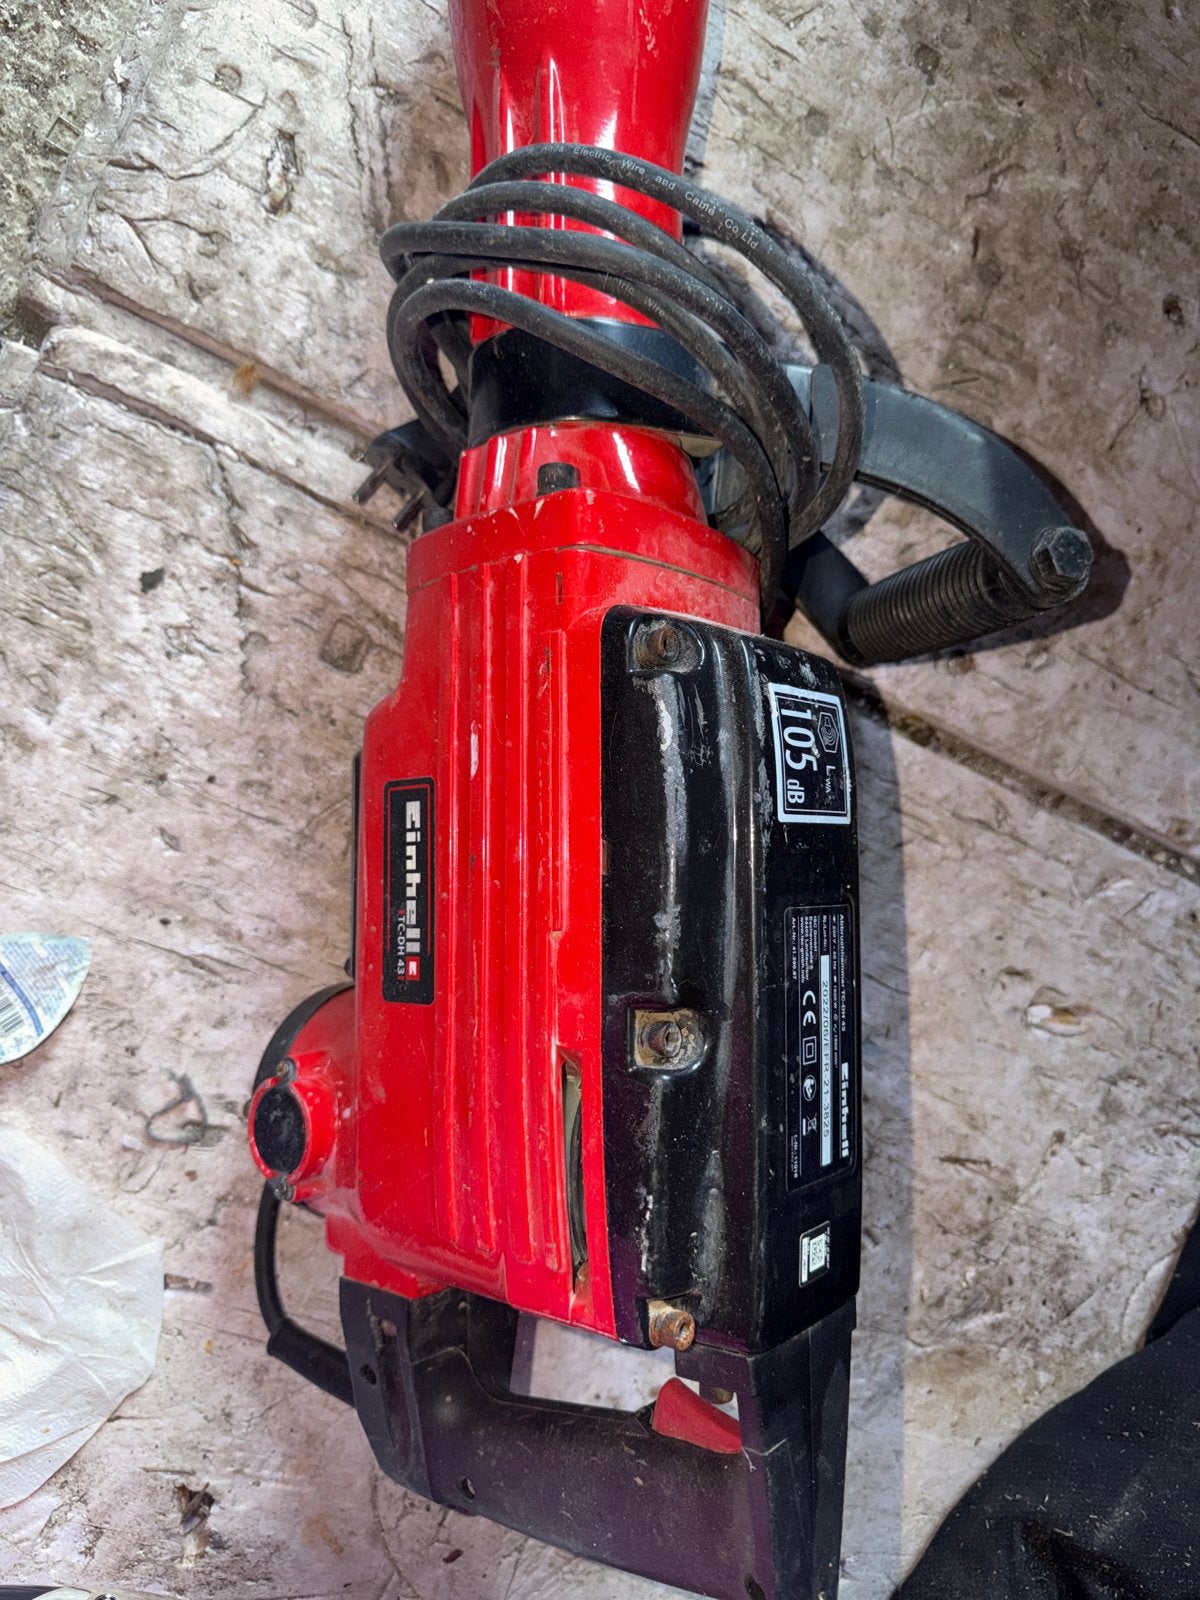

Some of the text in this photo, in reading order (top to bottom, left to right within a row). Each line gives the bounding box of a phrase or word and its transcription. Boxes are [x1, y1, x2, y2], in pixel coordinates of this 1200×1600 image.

[573, 146, 612, 162] Electric
[621, 158, 646, 175] Wire
[655, 175, 676, 190] and
[685, 191, 716, 216] Cable
[724, 219, 739, 233] Co
[741, 231, 759, 250] Ltd
[781, 709, 818, 804] 105 dB
[405, 801, 421, 953] Einhell
[397, 916, 405, 976] TC-DH 43
[822, 980, 830, 1138] 2022/06/EFR-21-3825
[841, 1062, 849, 1158] Einhell
